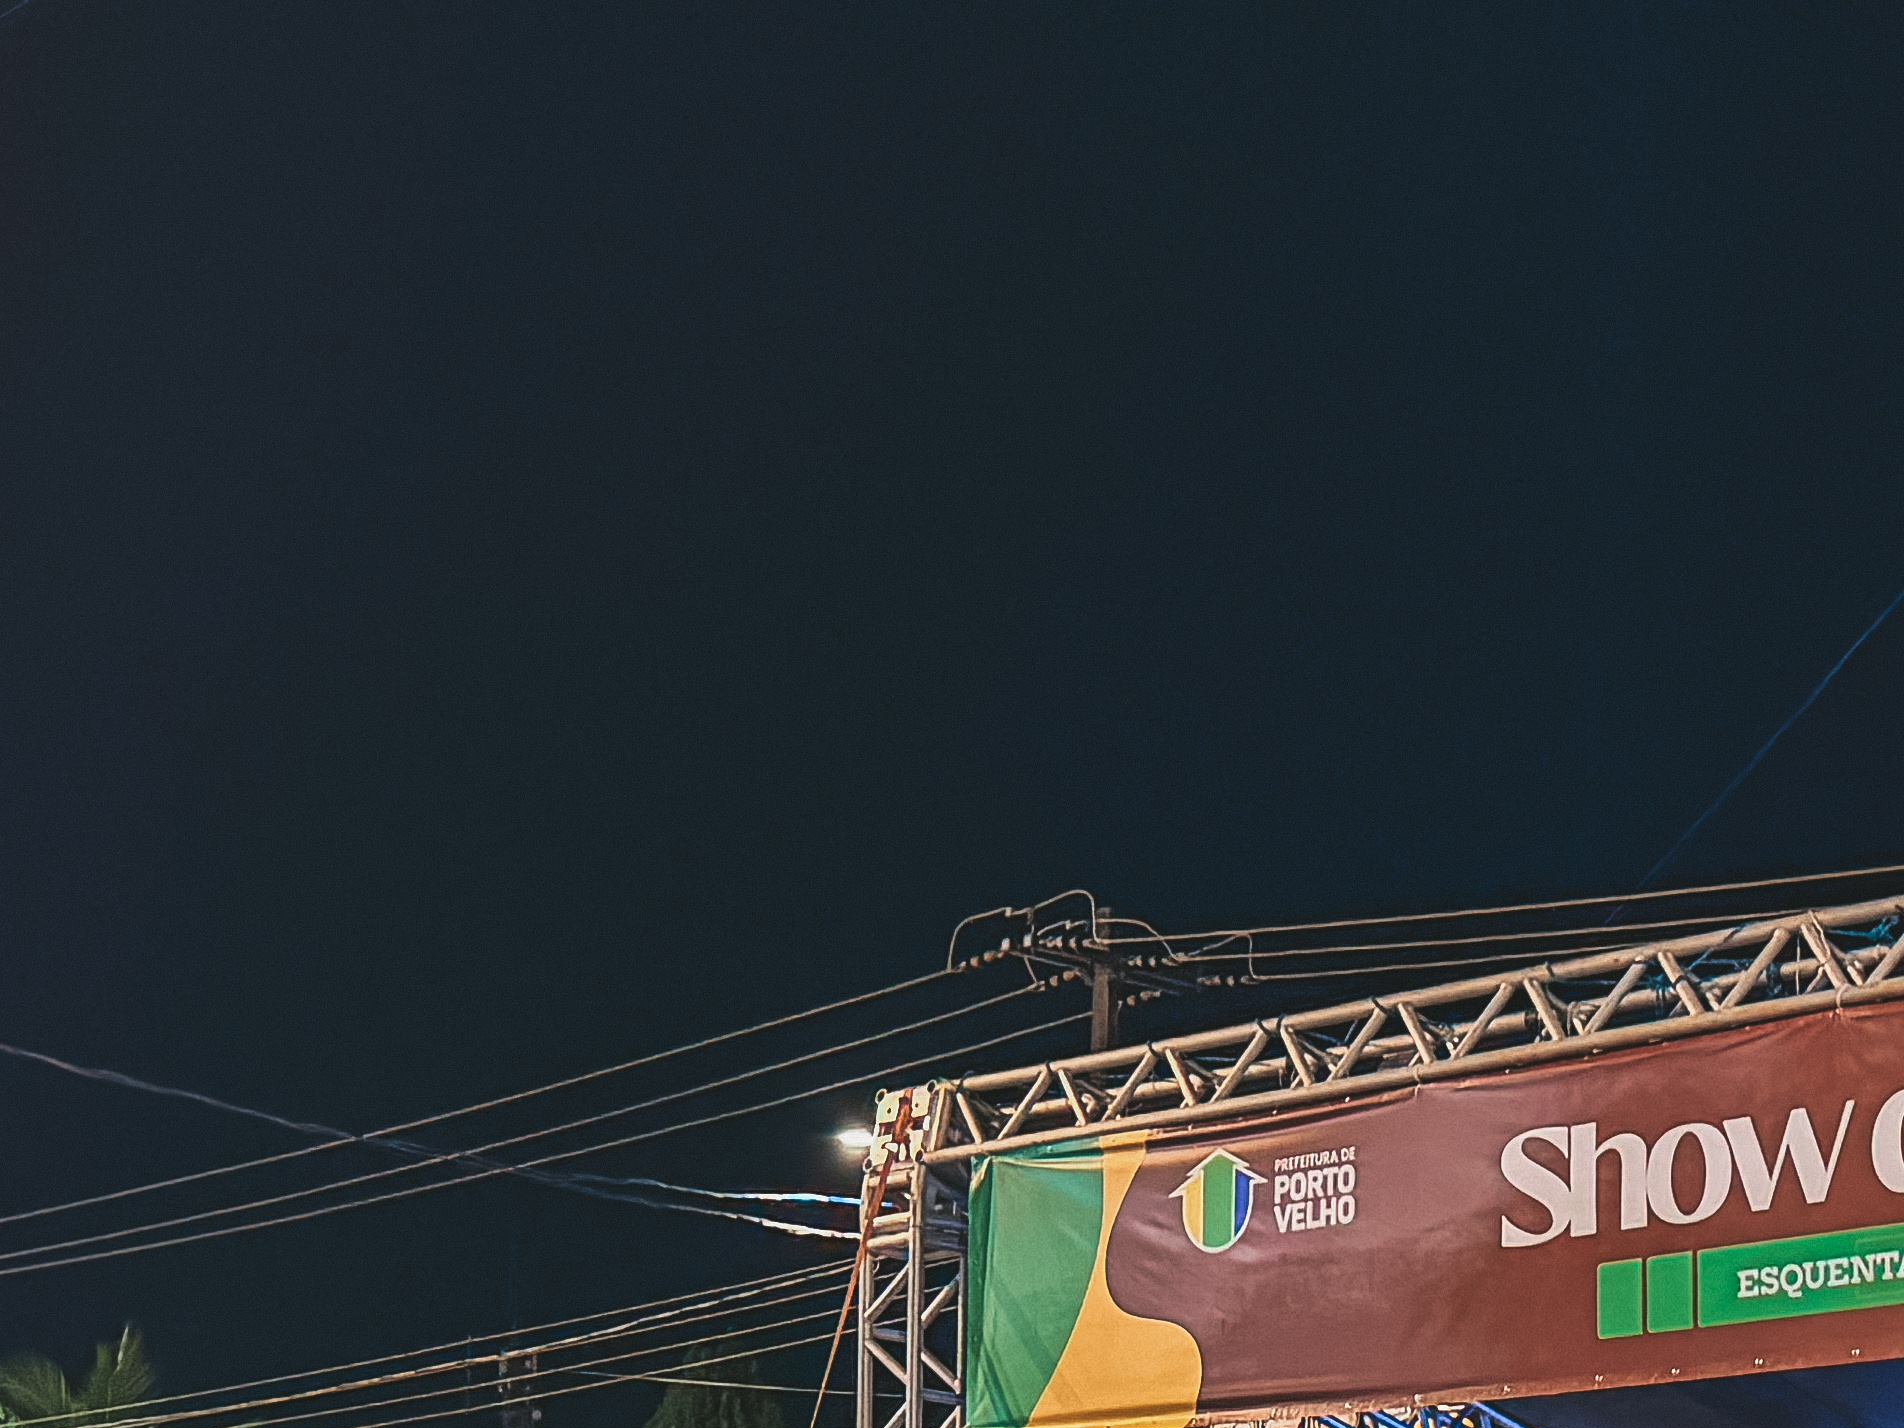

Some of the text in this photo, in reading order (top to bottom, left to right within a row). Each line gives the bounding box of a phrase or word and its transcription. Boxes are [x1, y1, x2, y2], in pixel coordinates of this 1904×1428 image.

[1274, 1146, 1356, 1172] PREFEITURA DE
[1273, 1164, 1356, 1204] PORTO
[1273, 1195, 1356, 1233] VELHO
